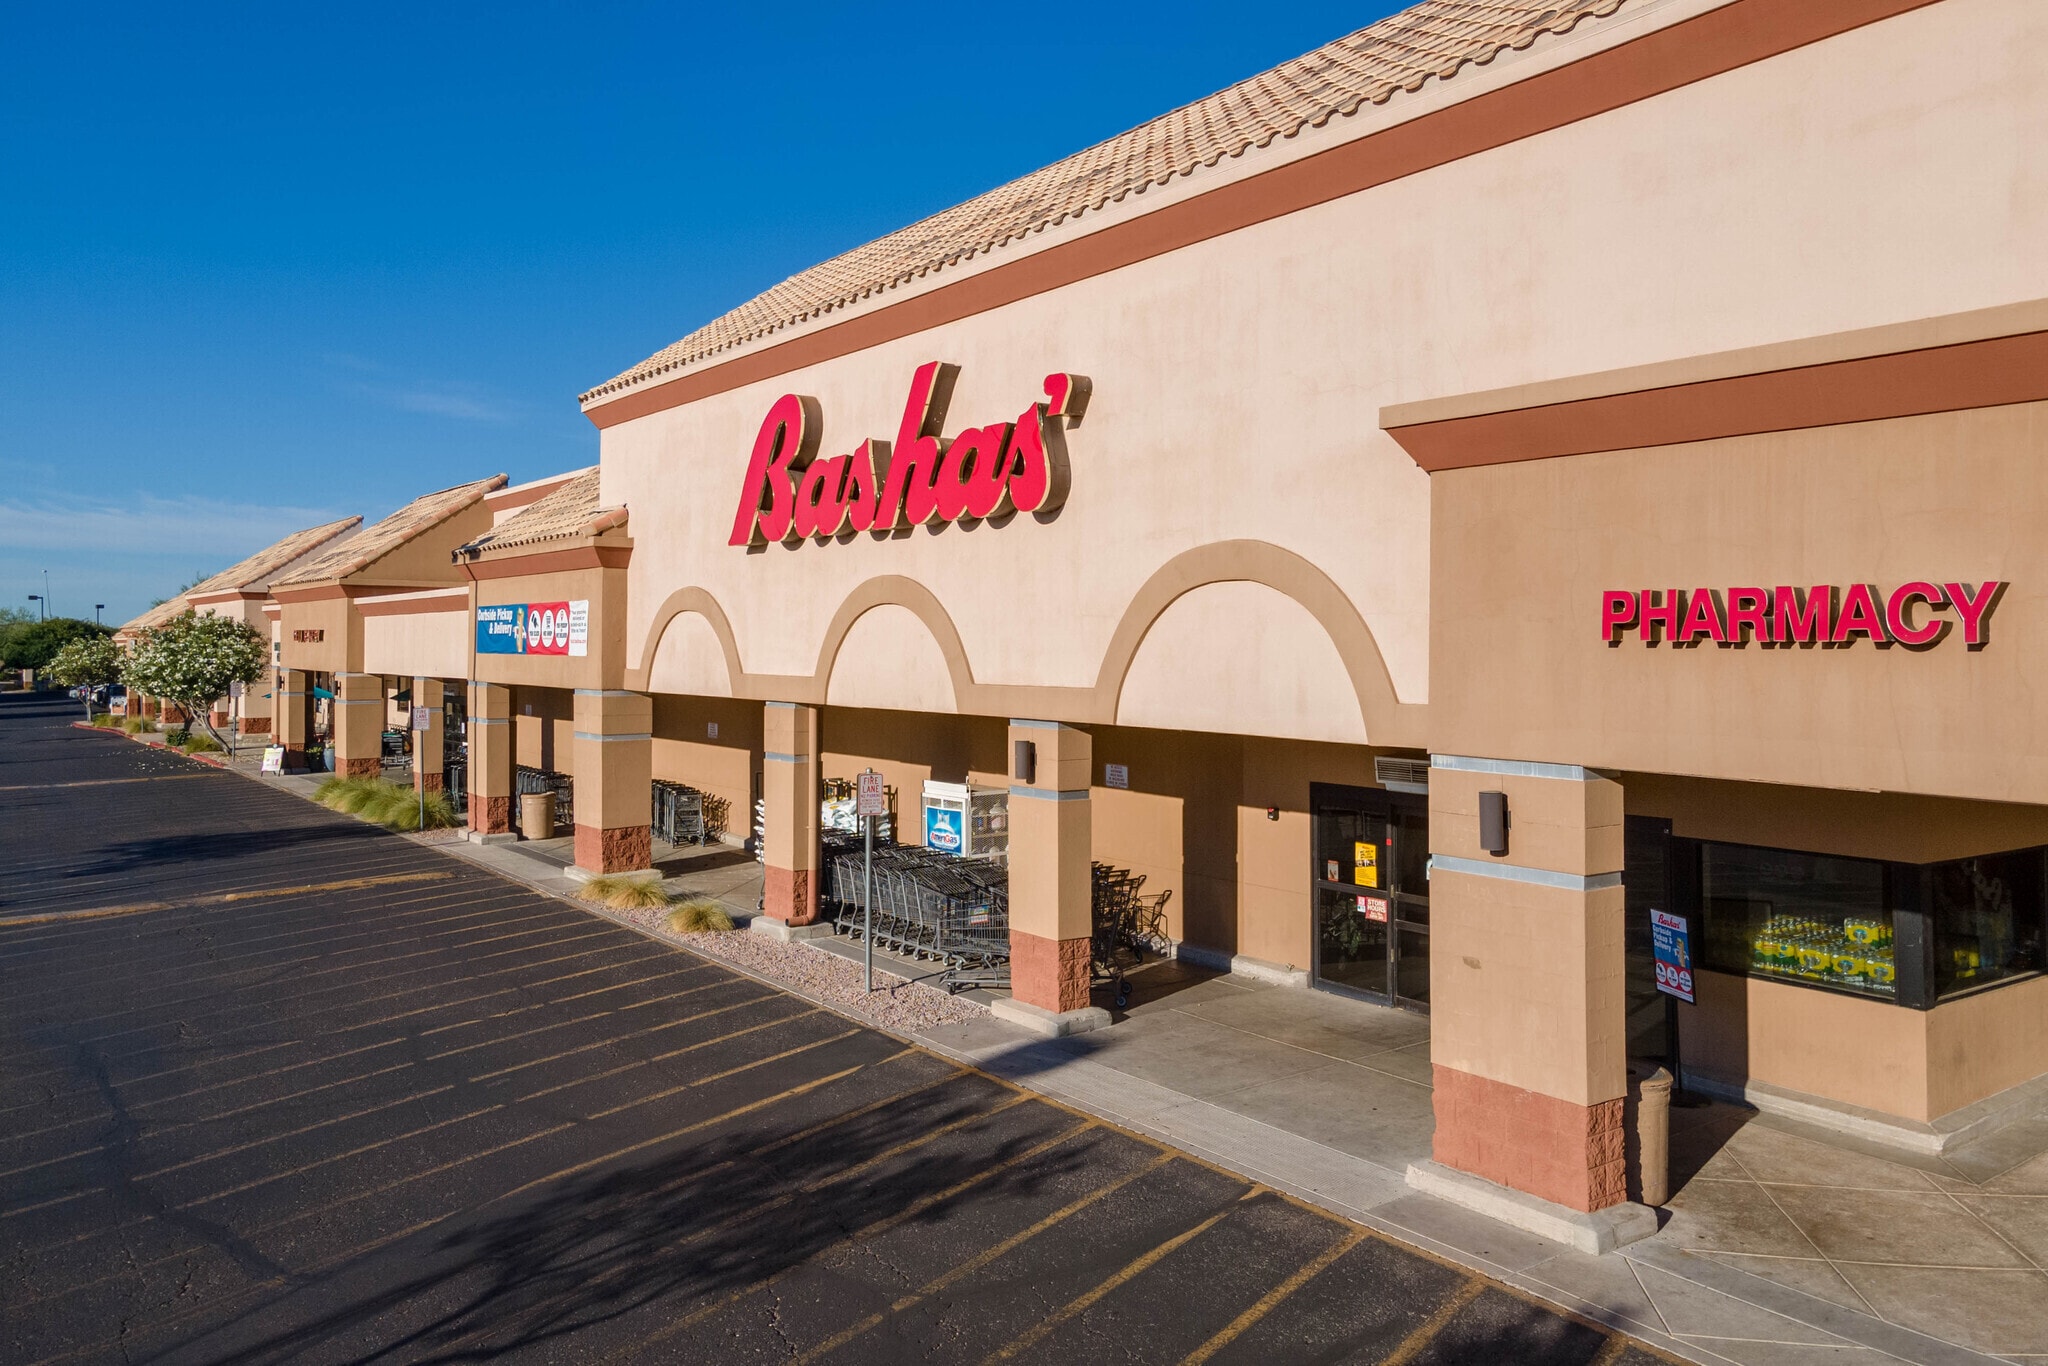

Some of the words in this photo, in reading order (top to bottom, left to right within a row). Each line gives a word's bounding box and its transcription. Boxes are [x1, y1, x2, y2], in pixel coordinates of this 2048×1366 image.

[729, 361, 1086, 549] Bashas'
[477, 608, 496, 621] Curbside
[497, 608, 513, 623] Pickup
[1602, 581, 2004, 648] PHARMACY
[494, 622, 512, 637] Delivery
[864, 776, 879, 785] FIRE
[862, 785, 879, 793] LANE
[931, 832, 957, 844] AmeriGas
[1368, 899, 1385, 907] STORE
[1368, 905, 1386, 913] HOURS
[1653, 924, 1671, 936] Curbside
[1653, 931, 1668, 944] Pickup
[1654, 939, 1671, 953] Delivery
